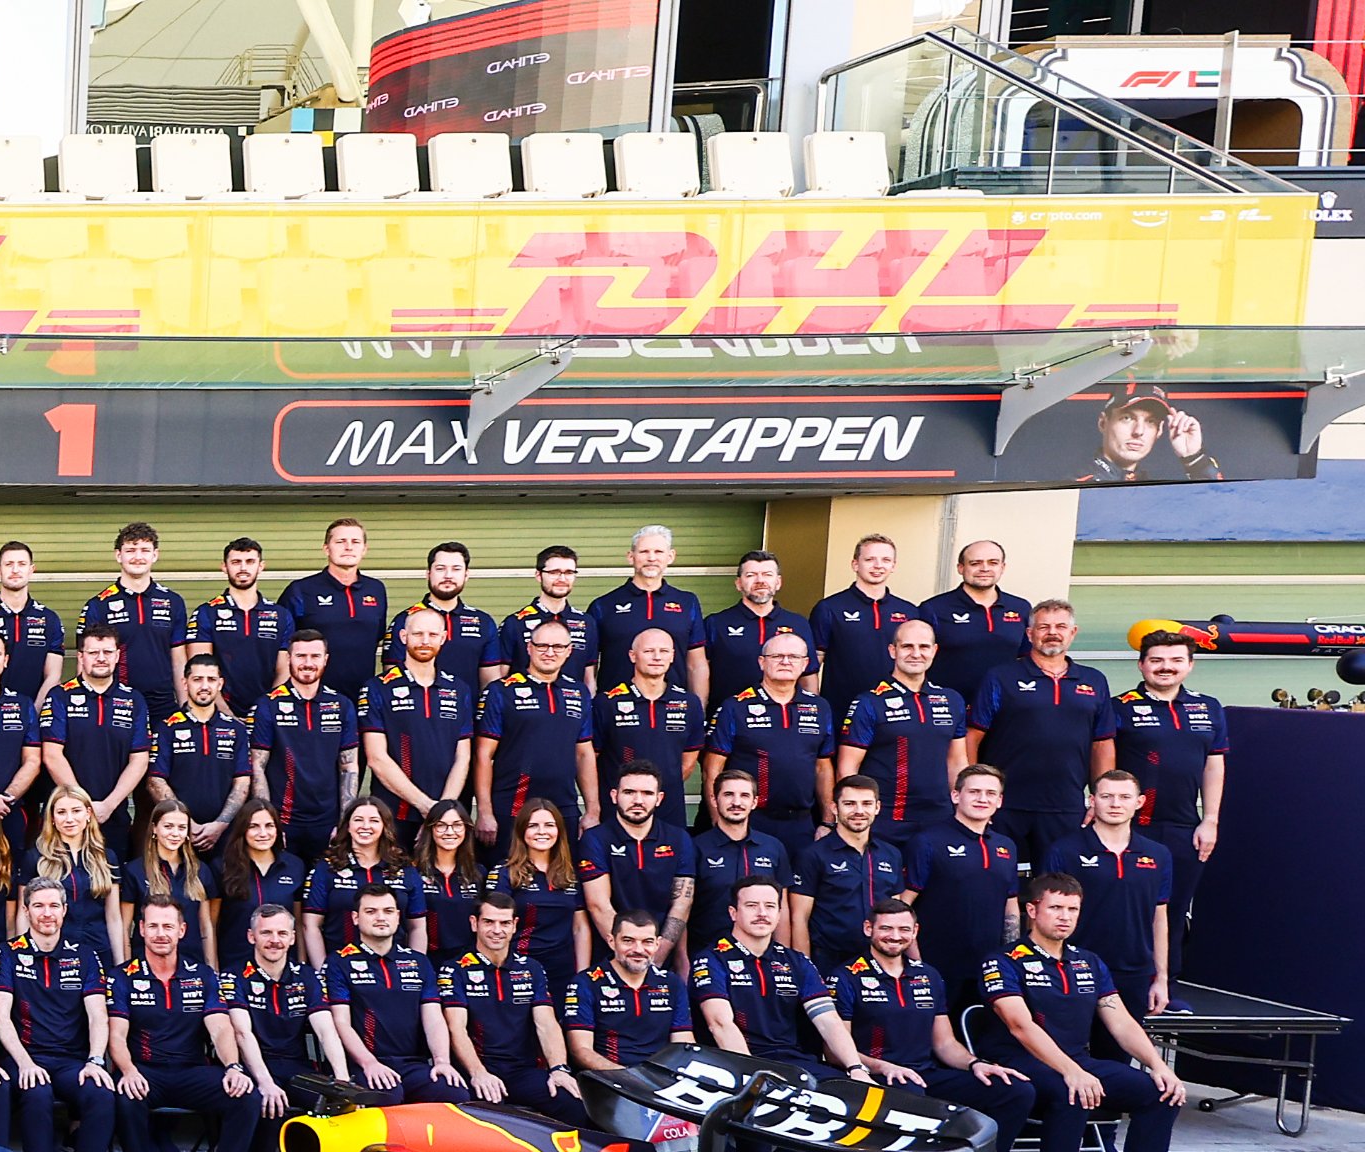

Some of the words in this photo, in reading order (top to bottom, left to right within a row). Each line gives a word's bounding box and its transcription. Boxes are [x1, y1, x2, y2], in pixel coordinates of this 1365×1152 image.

[491, 229, 1074, 346] DHL
[43, 403, 97, 478] 1
[504, 414, 925, 465] VERSTAPPEN
